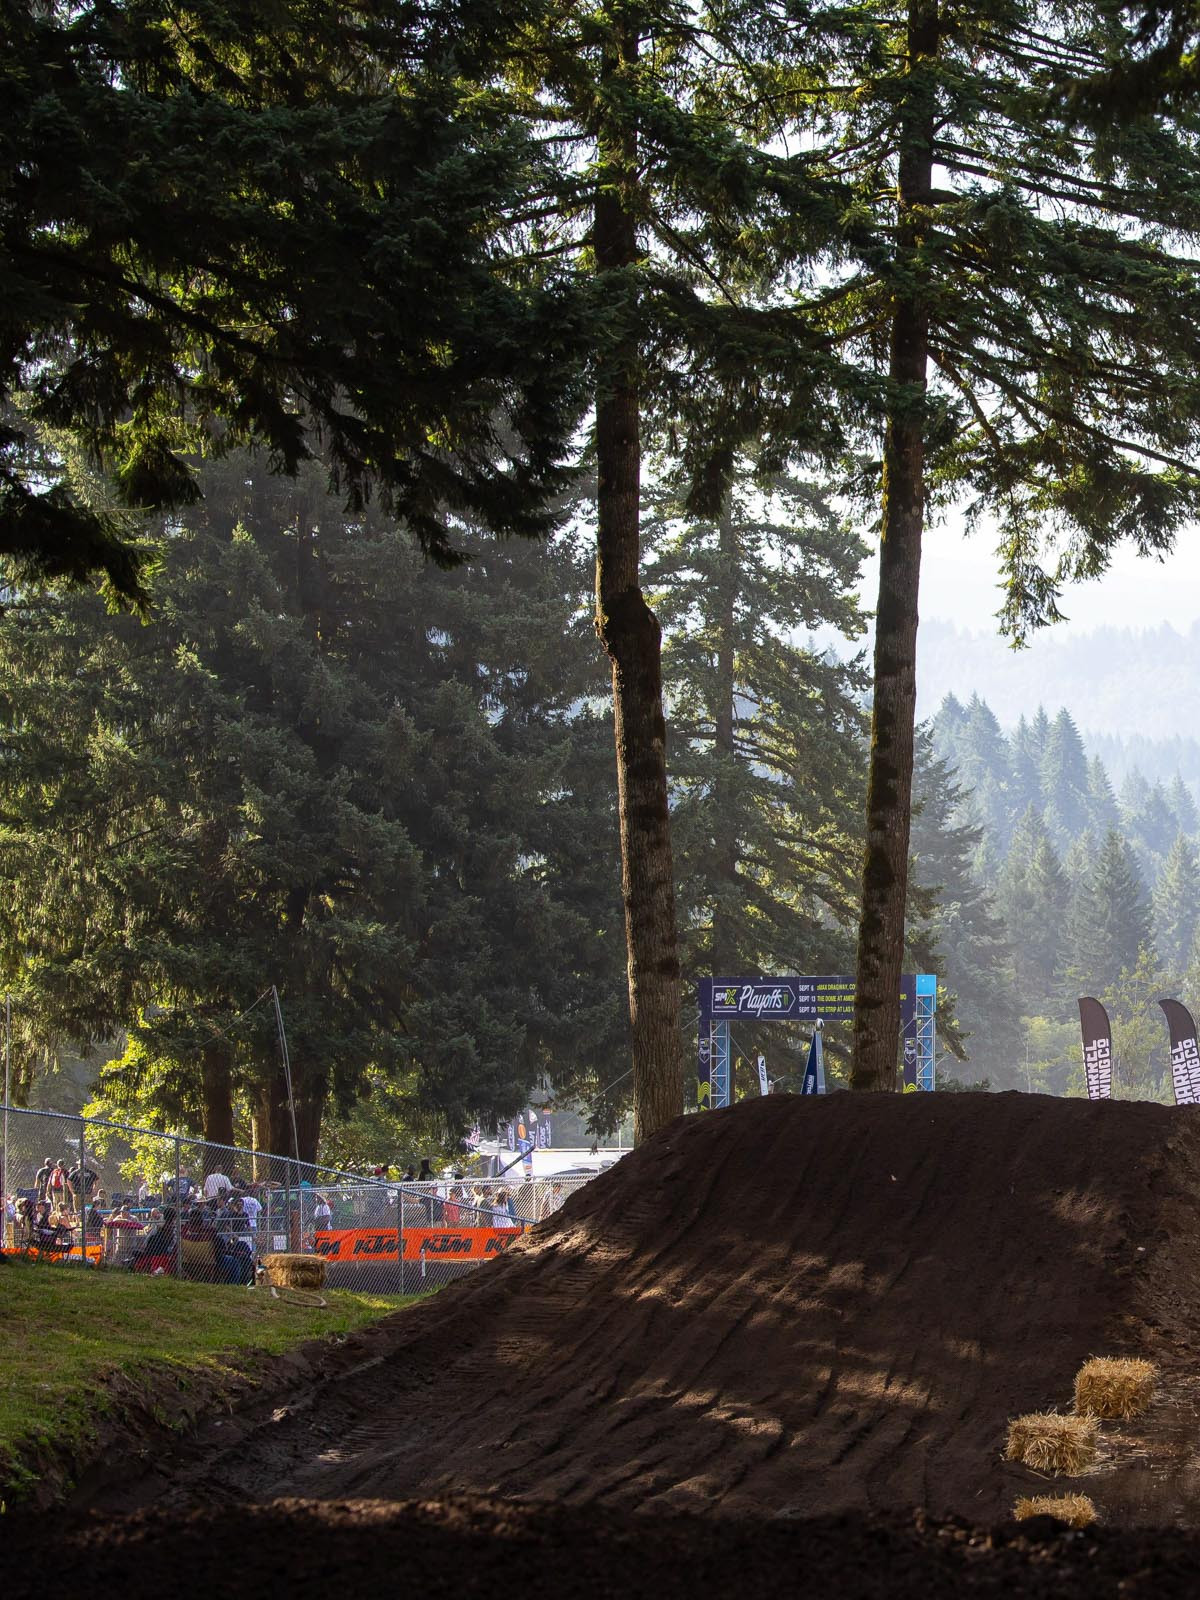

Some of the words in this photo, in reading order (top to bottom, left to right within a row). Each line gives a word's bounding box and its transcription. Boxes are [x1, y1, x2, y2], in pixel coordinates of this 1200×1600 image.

[714, 989, 737, 1005] SMX
[738, 985, 782, 1017] Playoffs
[1085, 1039, 1100, 1100] ARREL
[312, 1237, 340, 1255] TM
[353, 1235, 407, 1254] KTM
[419, 1234, 472, 1253] KTM
[485, 1234, 516, 1252] KT
